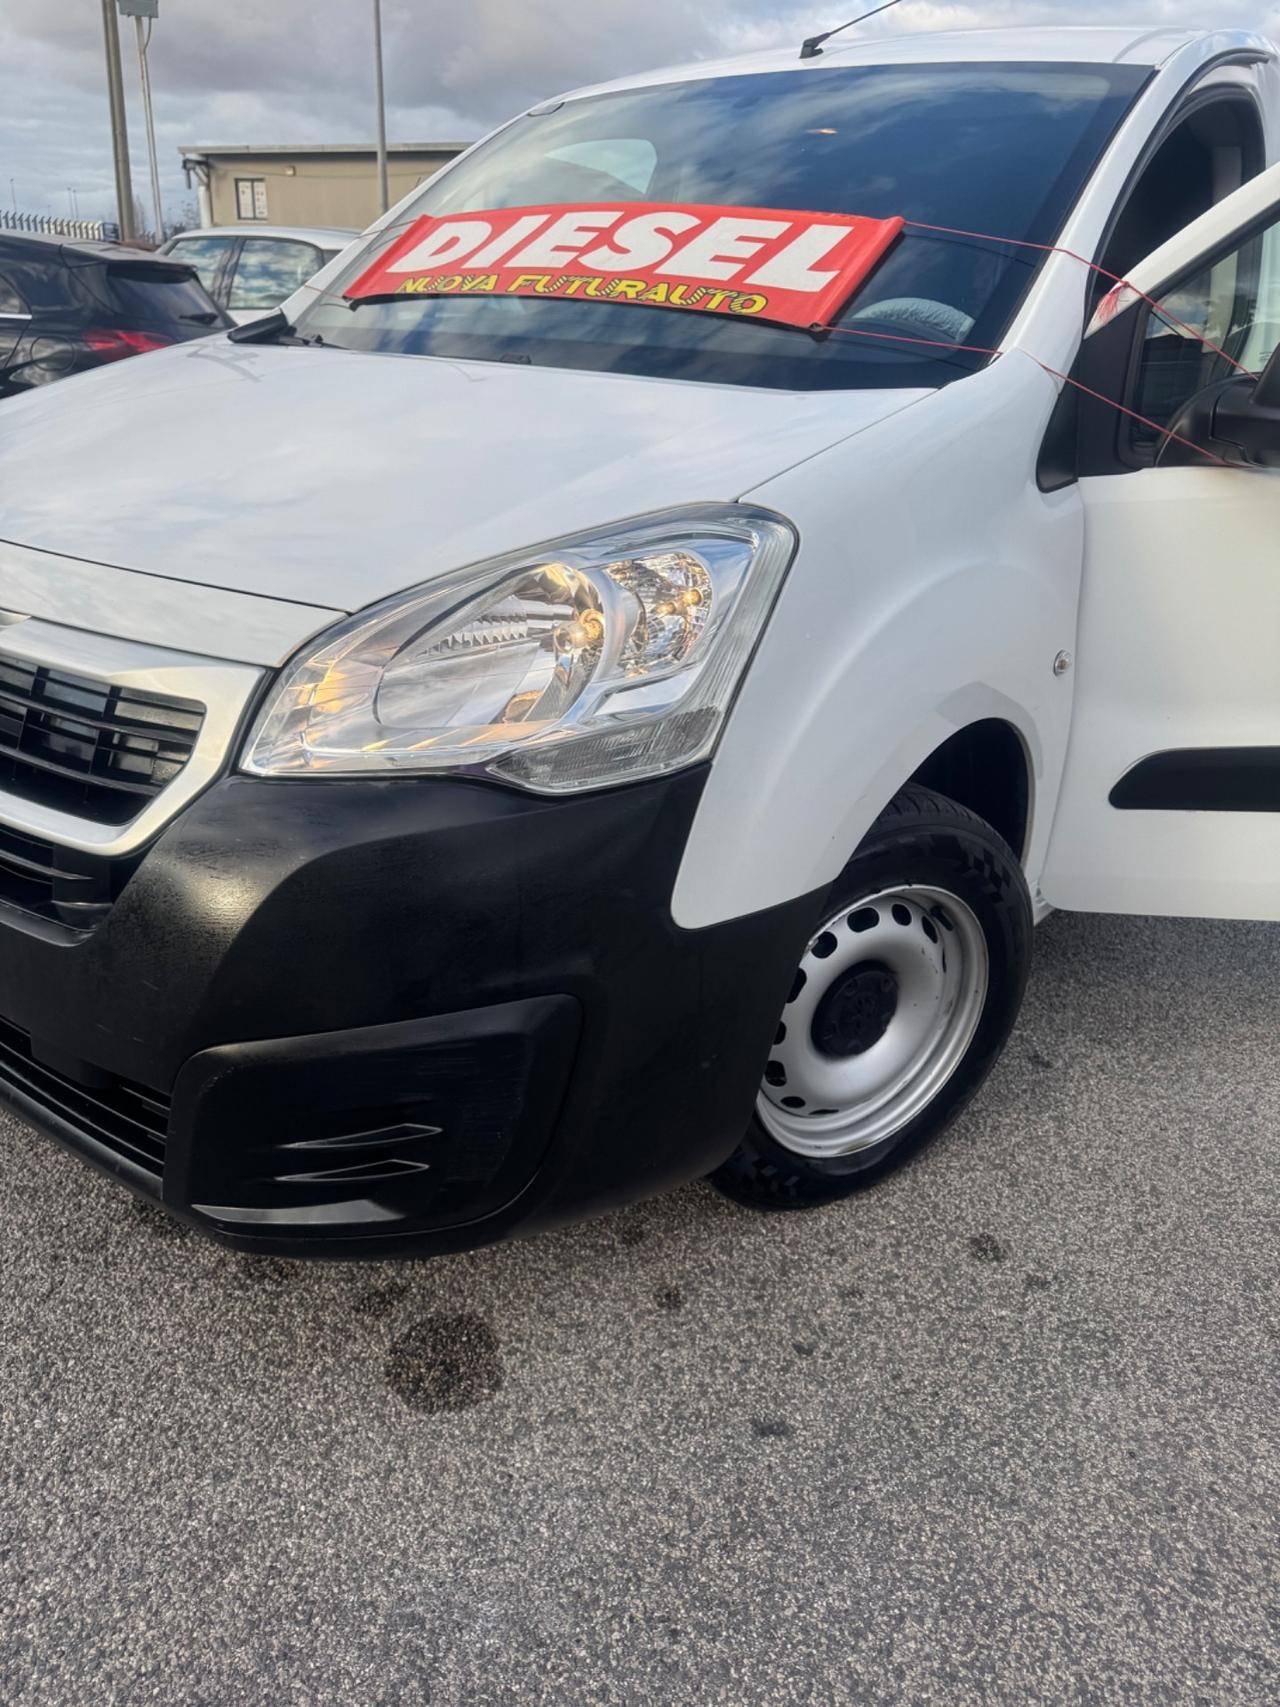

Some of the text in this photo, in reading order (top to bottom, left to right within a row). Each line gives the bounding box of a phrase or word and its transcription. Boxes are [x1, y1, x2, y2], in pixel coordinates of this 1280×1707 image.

[386, 211, 854, 292] DIESEL
[400, 274, 768, 315] NUOVA FUTURAUTO
